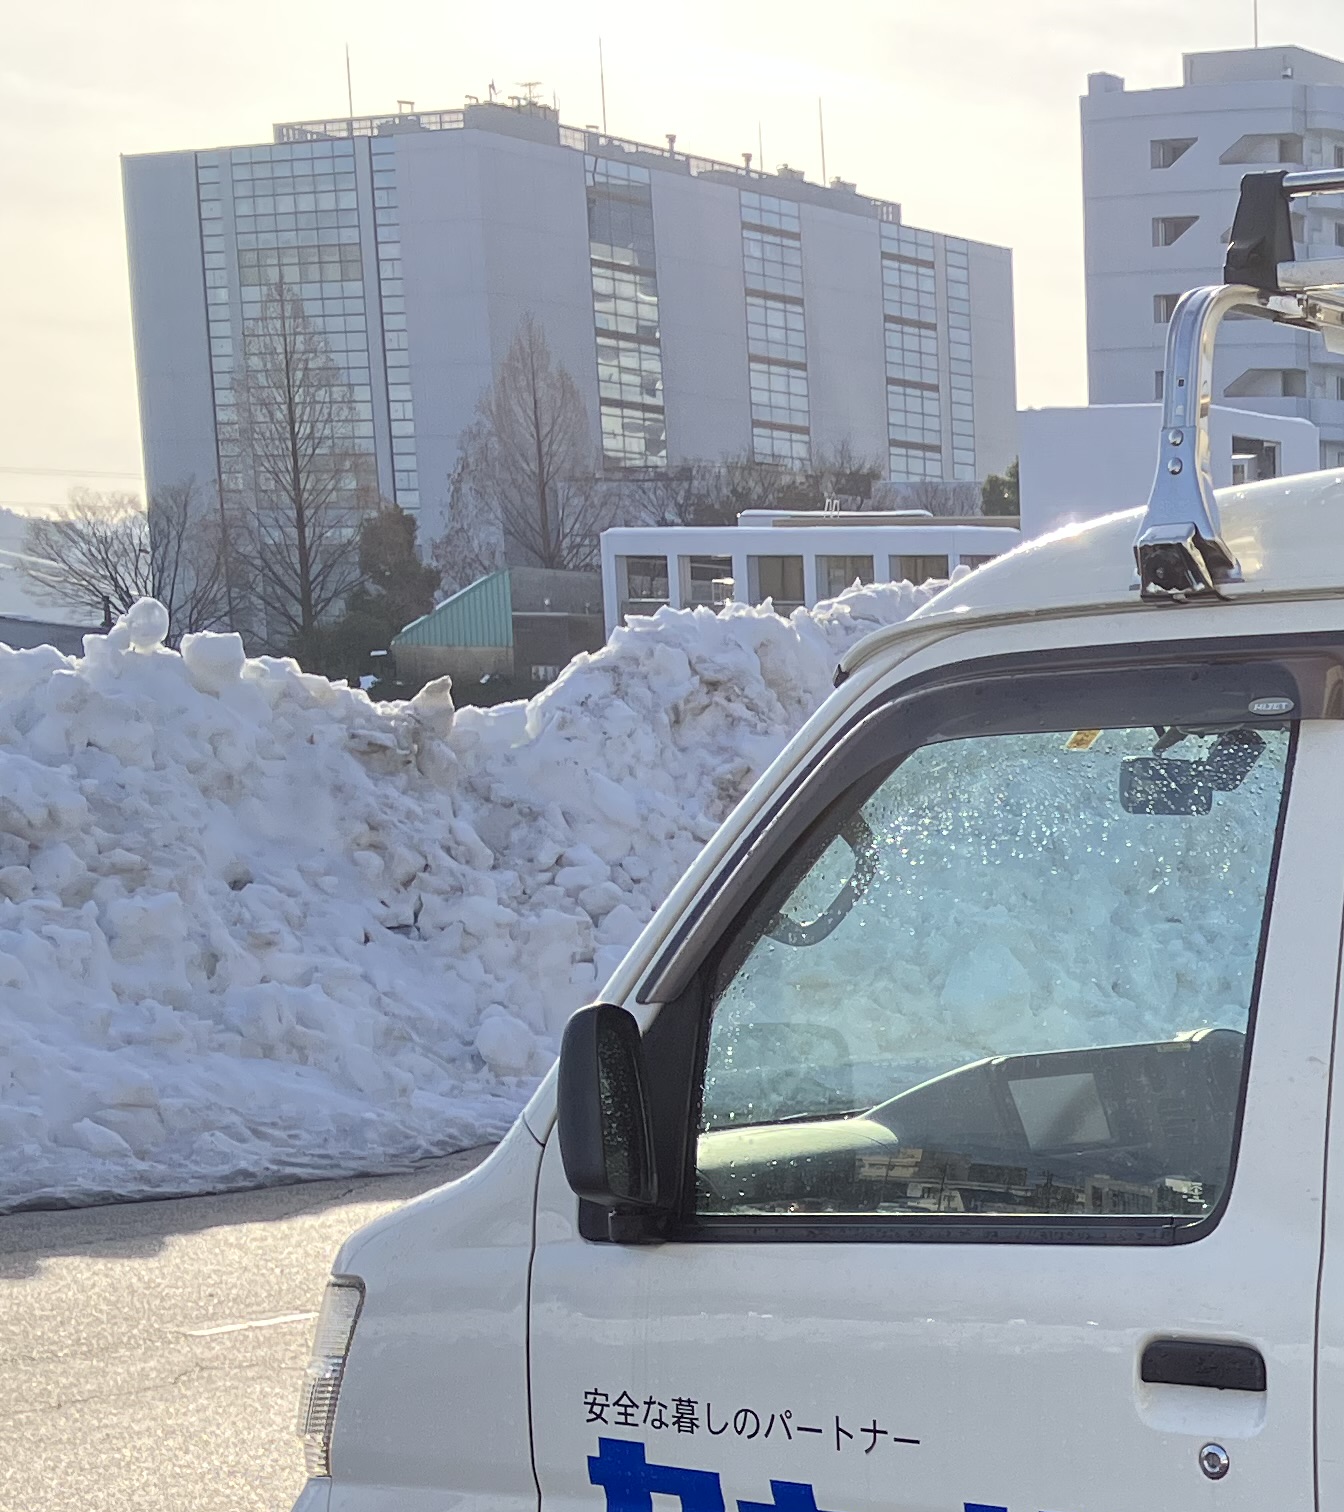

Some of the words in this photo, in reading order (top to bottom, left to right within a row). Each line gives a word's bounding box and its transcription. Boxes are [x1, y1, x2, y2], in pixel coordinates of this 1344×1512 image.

[583, 1387, 920, 1454] 安全な暮しのパートナー
